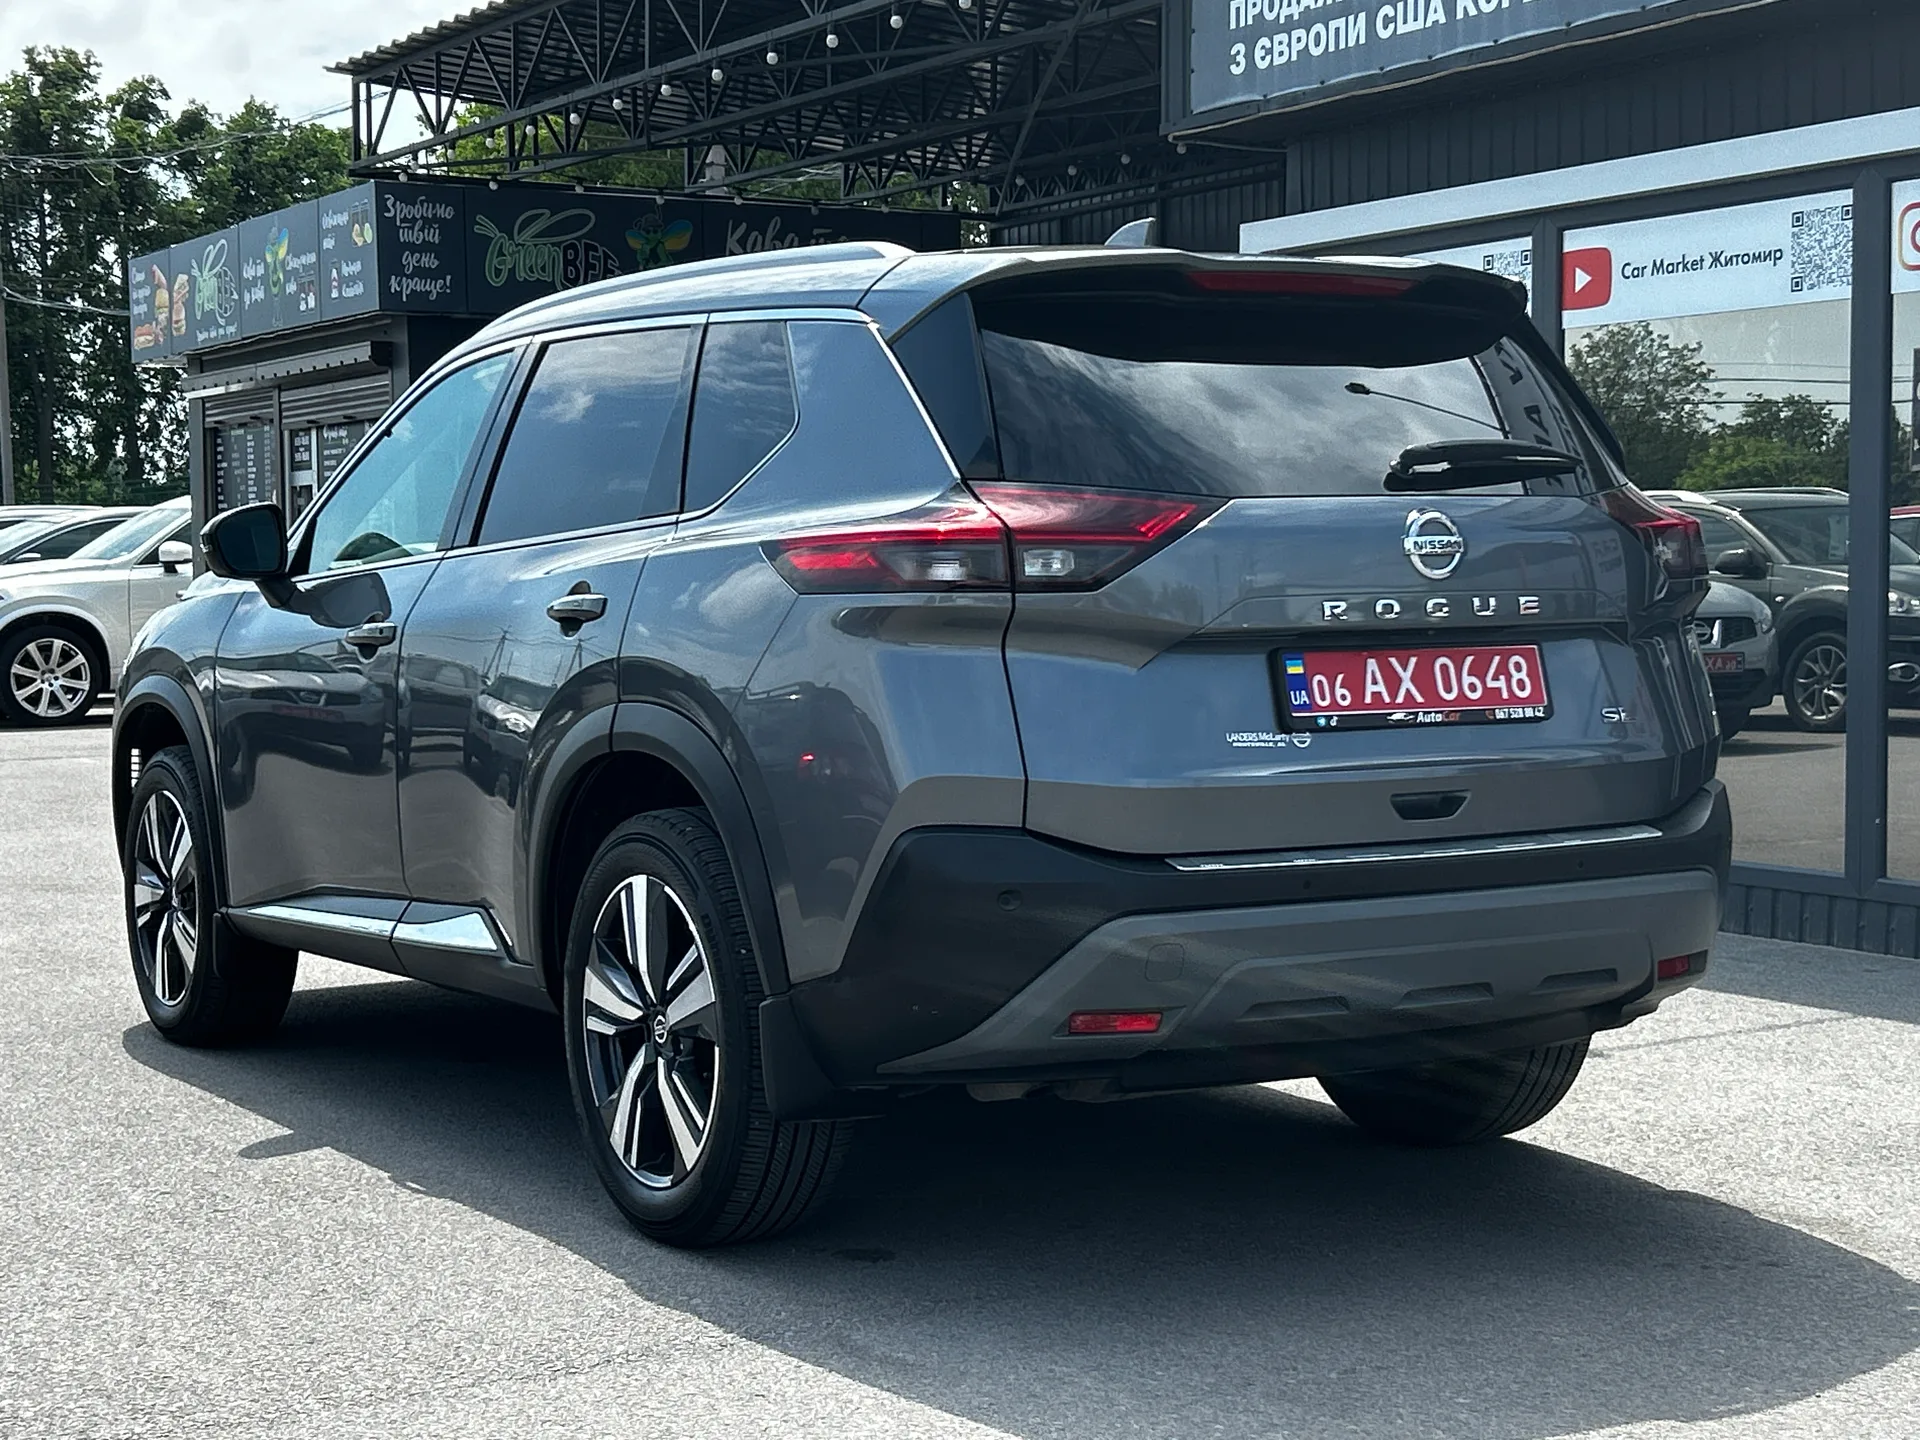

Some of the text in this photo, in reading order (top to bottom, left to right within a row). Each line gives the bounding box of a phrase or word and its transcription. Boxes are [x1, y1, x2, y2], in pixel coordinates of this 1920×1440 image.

[1254, 11, 1366, 70] ЄВРОПИ
[1375, 0, 1447, 39] США
[383, 194, 455, 226] Зробимо
[399, 219, 442, 244] твій
[402, 249, 440, 275] день
[1621, 246, 1784, 281] Car Market Житомир
[388, 274, 453, 302] краще!
[1413, 539, 1462, 551] NISSAN
[1321, 596, 1541, 621] ROGUE
[1311, 654, 1533, 708] 06 AX 0648
[1289, 690, 1310, 706] UA
